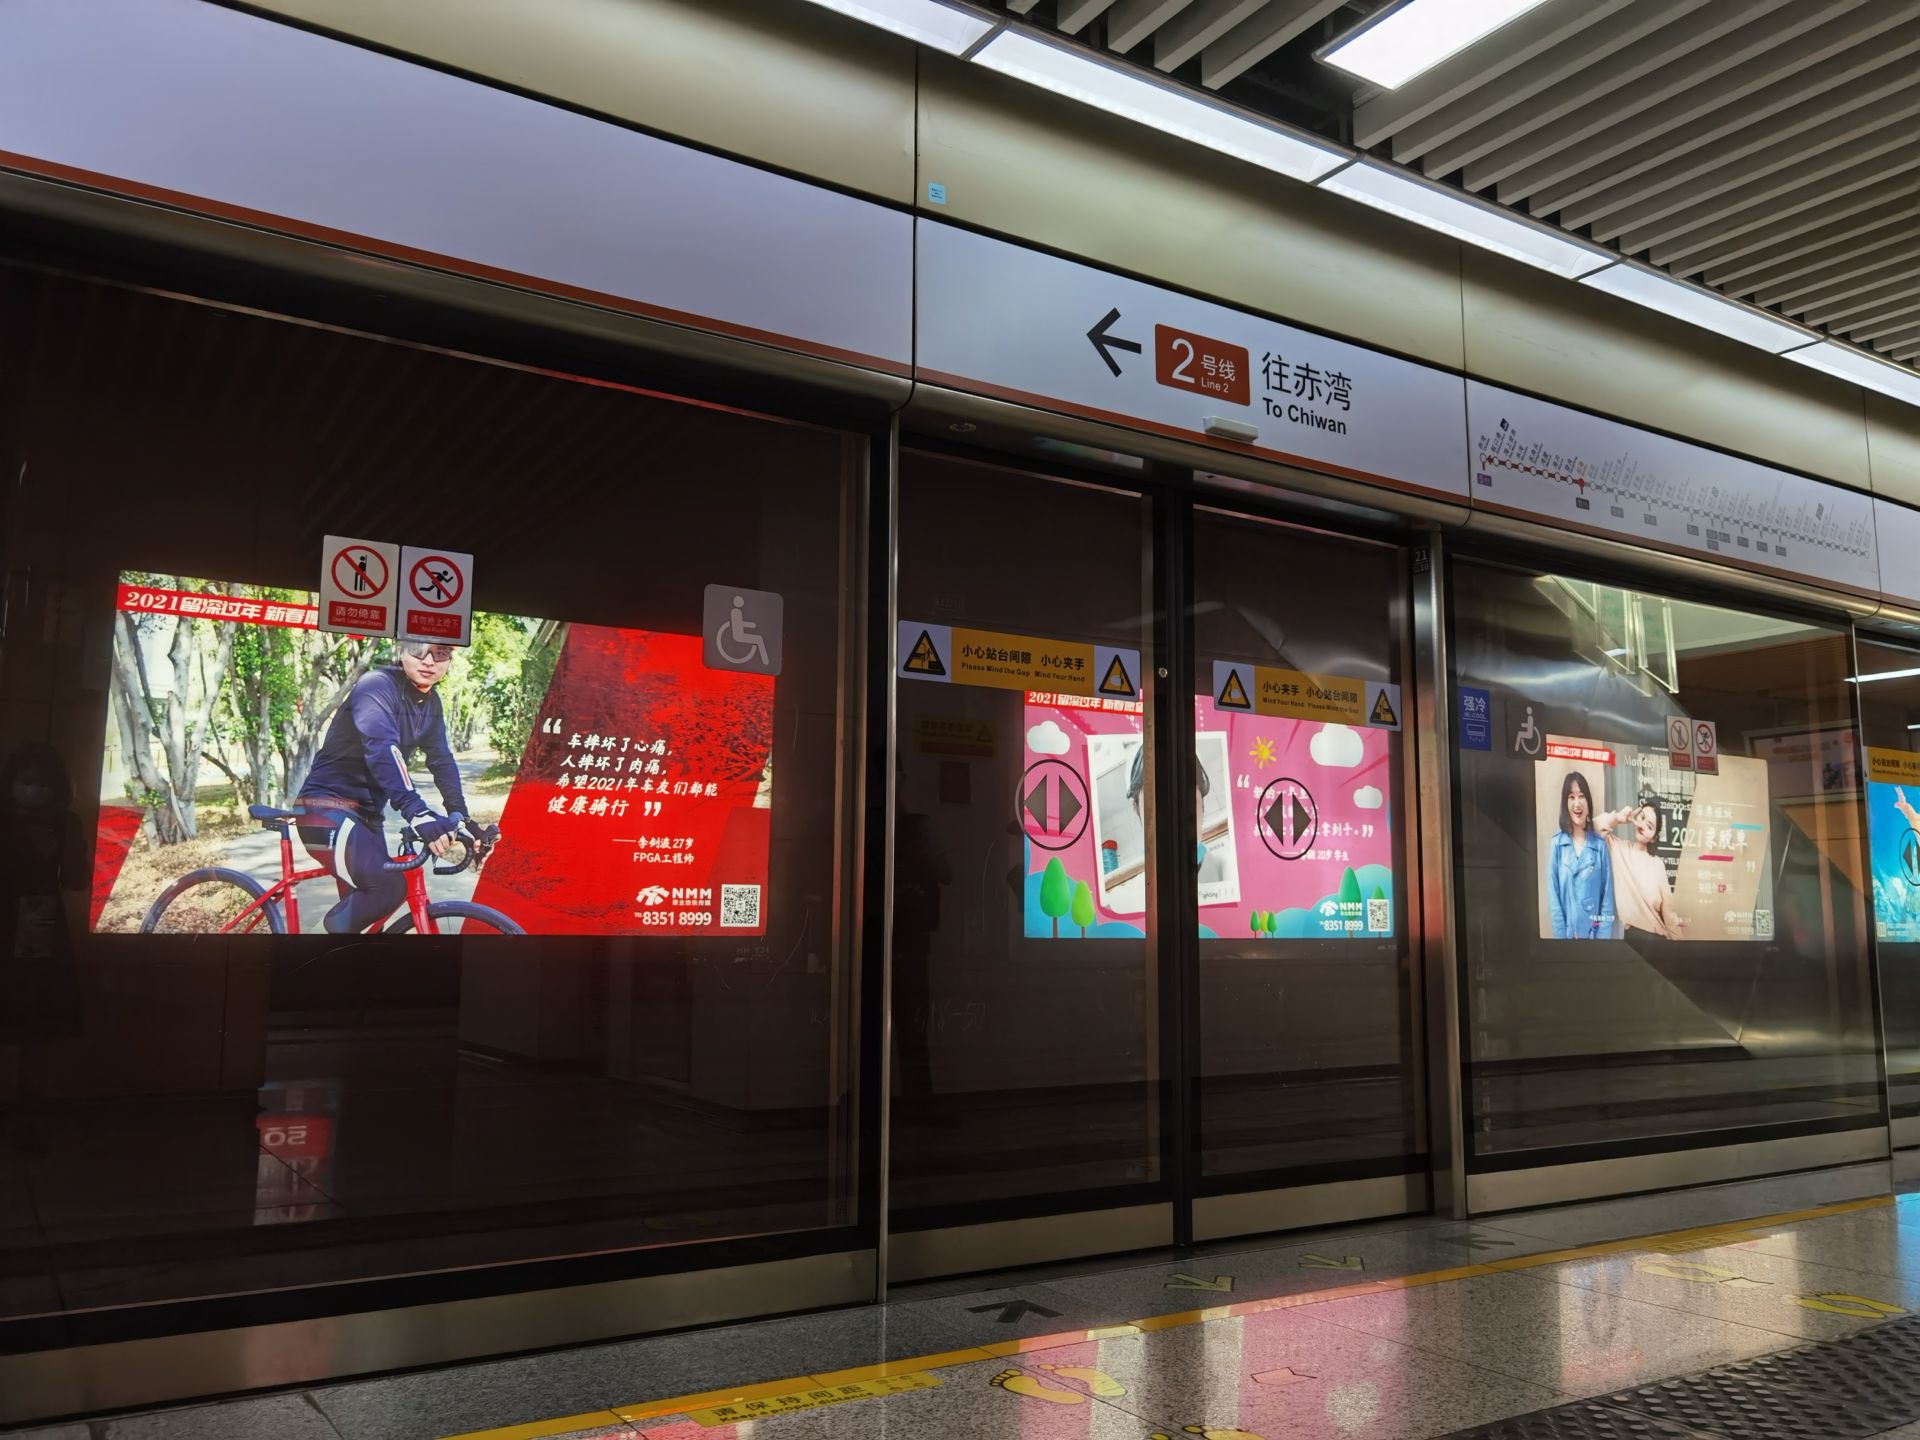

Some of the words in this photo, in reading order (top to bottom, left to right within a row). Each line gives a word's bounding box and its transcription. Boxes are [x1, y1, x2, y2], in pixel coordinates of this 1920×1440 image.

[1200, 376, 1221, 392] Line
[1223, 383, 1229, 393] 2
[1261, 351, 1352, 411] 往赤湾
[1262, 397, 1282, 418] To
[1288, 406, 1347, 435] Chiwan
[962, 644, 1031, 664] 小心站台间隙
[1041, 654, 1085, 671] 小心夹手
[961, 662, 985, 672] Please
[1017, 668, 1030, 677] Gap
[672, 887, 712, 899] NMM
[642, 911, 674, 925] 8351
[678, 911, 712, 926] 8999
